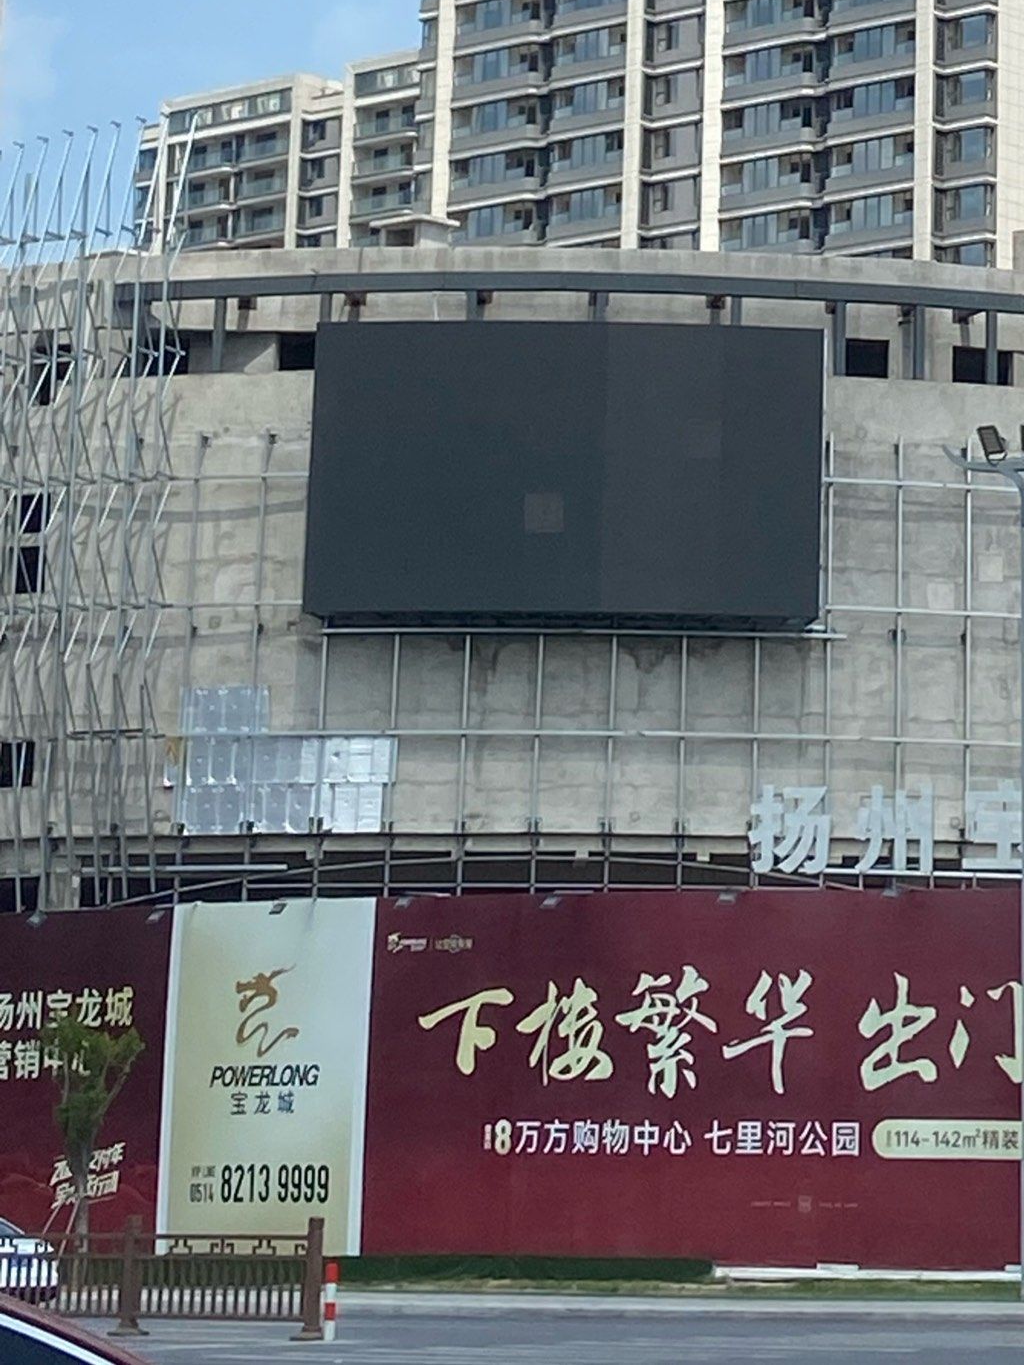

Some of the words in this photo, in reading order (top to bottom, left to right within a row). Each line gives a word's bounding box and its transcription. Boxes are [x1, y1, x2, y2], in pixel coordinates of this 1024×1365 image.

[209, 1064, 320, 1088] POWERLONG
[231, 1090, 295, 1115] 宝龙城
[704, 1120, 860, 1157] 七里河公园
[221, 1164, 270, 1204] 8213
[277, 1164, 330, 1204] 9999
